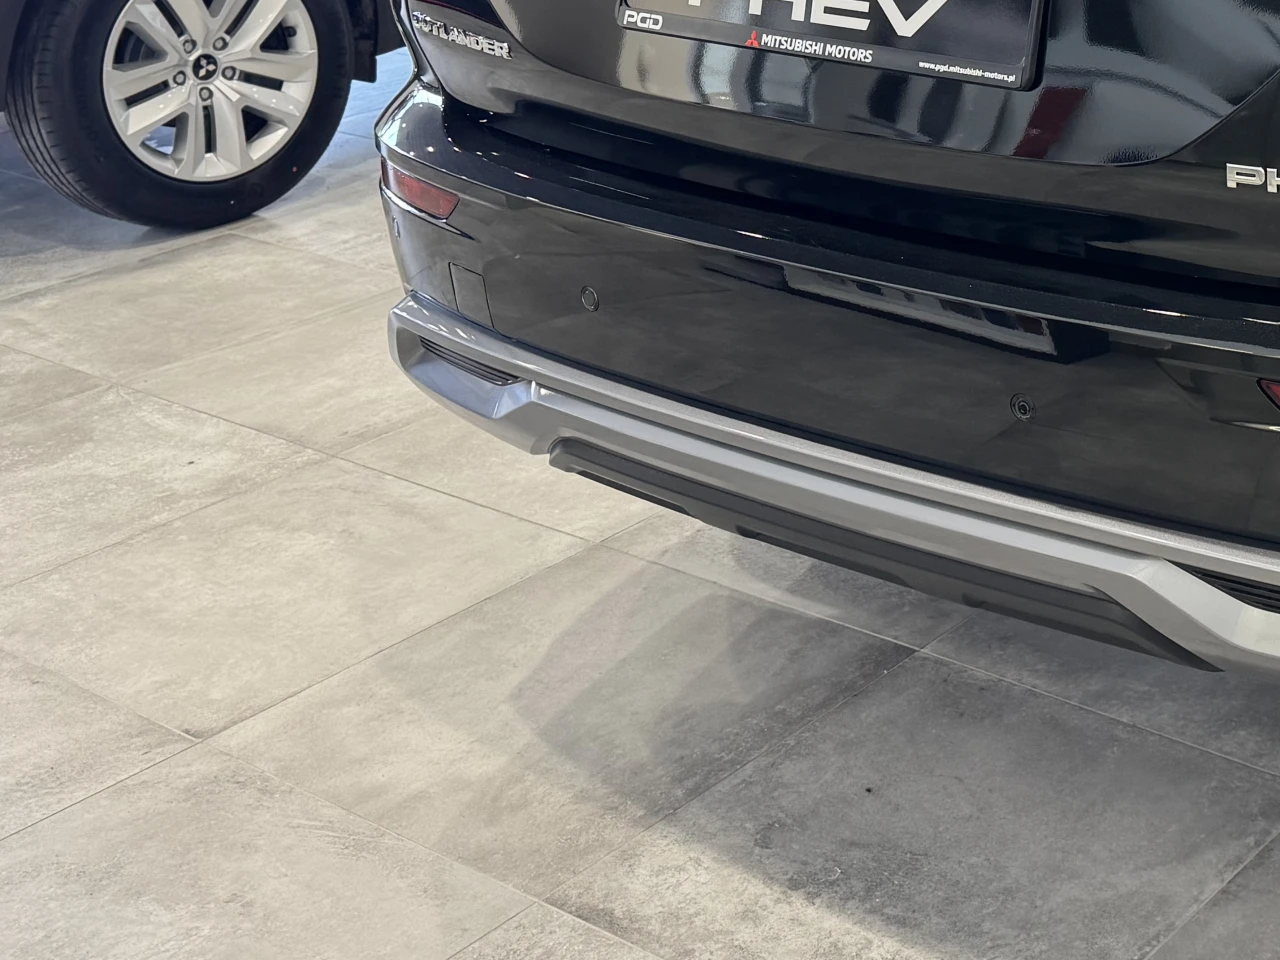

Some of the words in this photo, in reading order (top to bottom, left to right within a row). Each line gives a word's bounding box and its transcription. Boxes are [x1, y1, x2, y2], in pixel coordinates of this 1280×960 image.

[623, 9, 663, 30] PGD
[412, 11, 513, 60] OUTLANDER
[761, 33, 824, 54] MITSUBISHI
[825, 43, 873, 63] MOTORS
[918, 61, 1016, 83] www.pgd.mitsubishi-motors.pl
